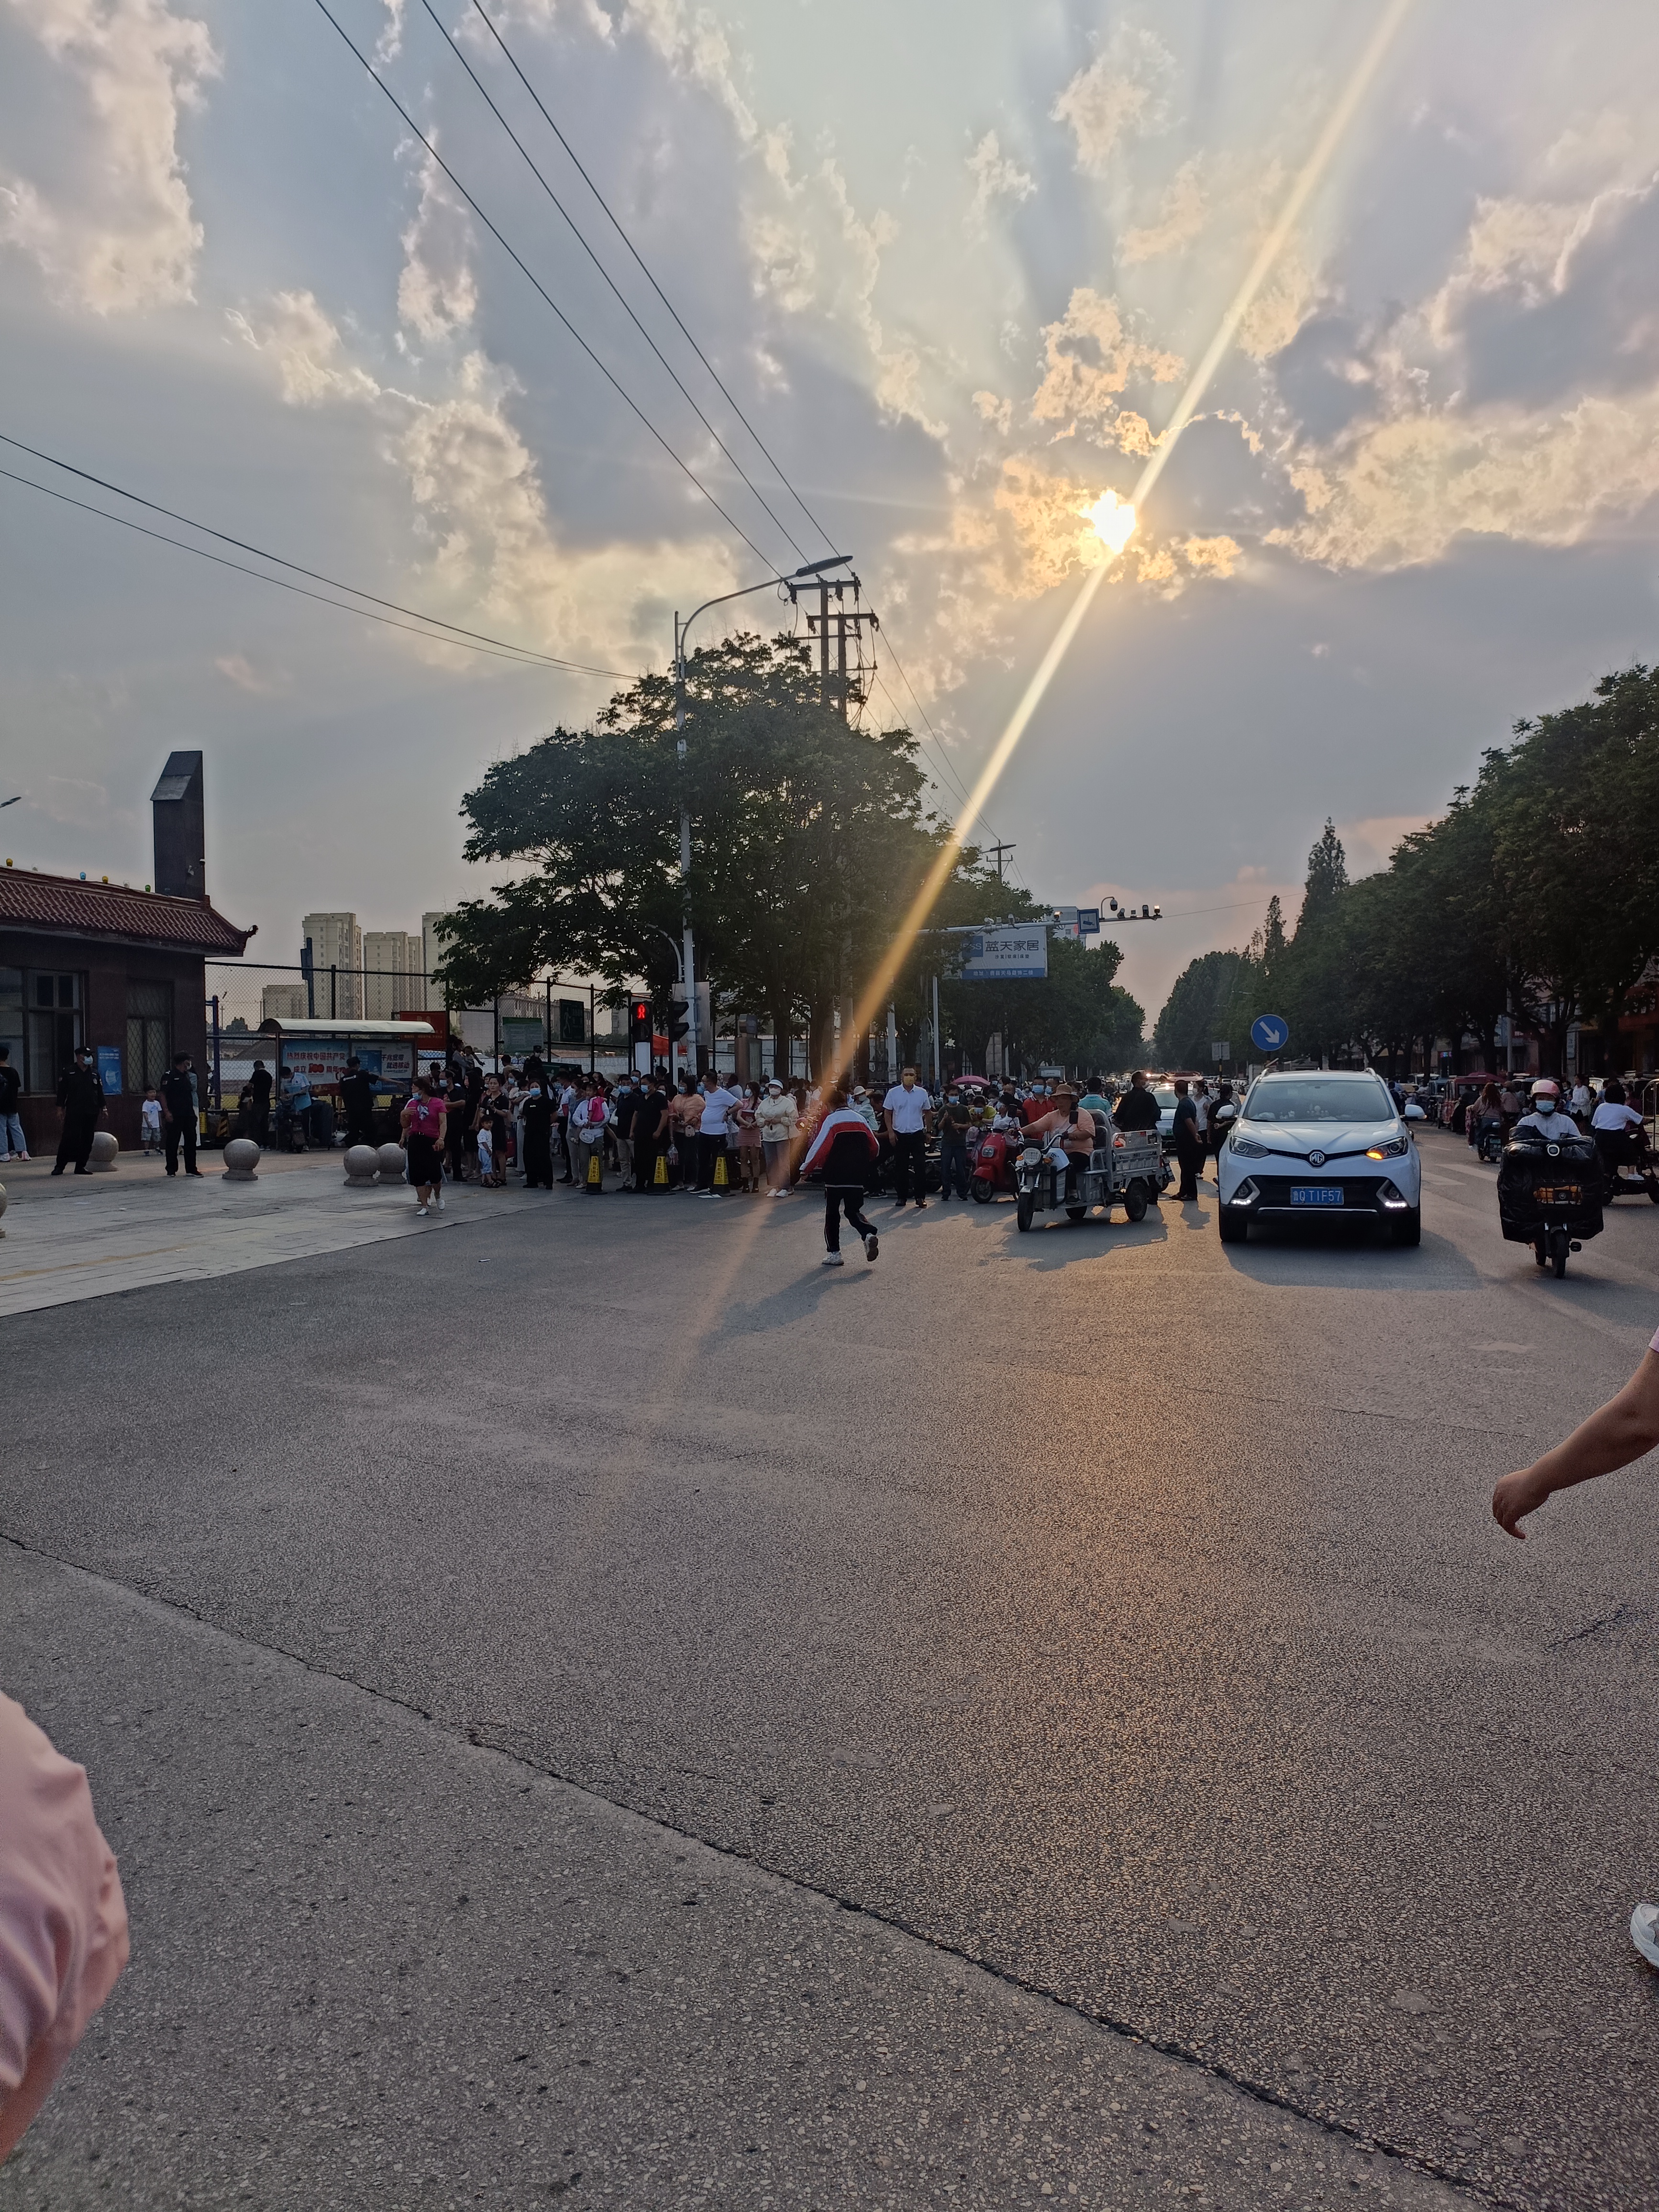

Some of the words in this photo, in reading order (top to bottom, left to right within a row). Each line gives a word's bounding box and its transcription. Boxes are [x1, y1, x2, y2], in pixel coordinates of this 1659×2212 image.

[985, 940, 1039, 951] 蓝天家居
[287, 1052, 345, 1060] 热烈庆祝中国共产党
[1311, 1153, 1323, 1163] MG
